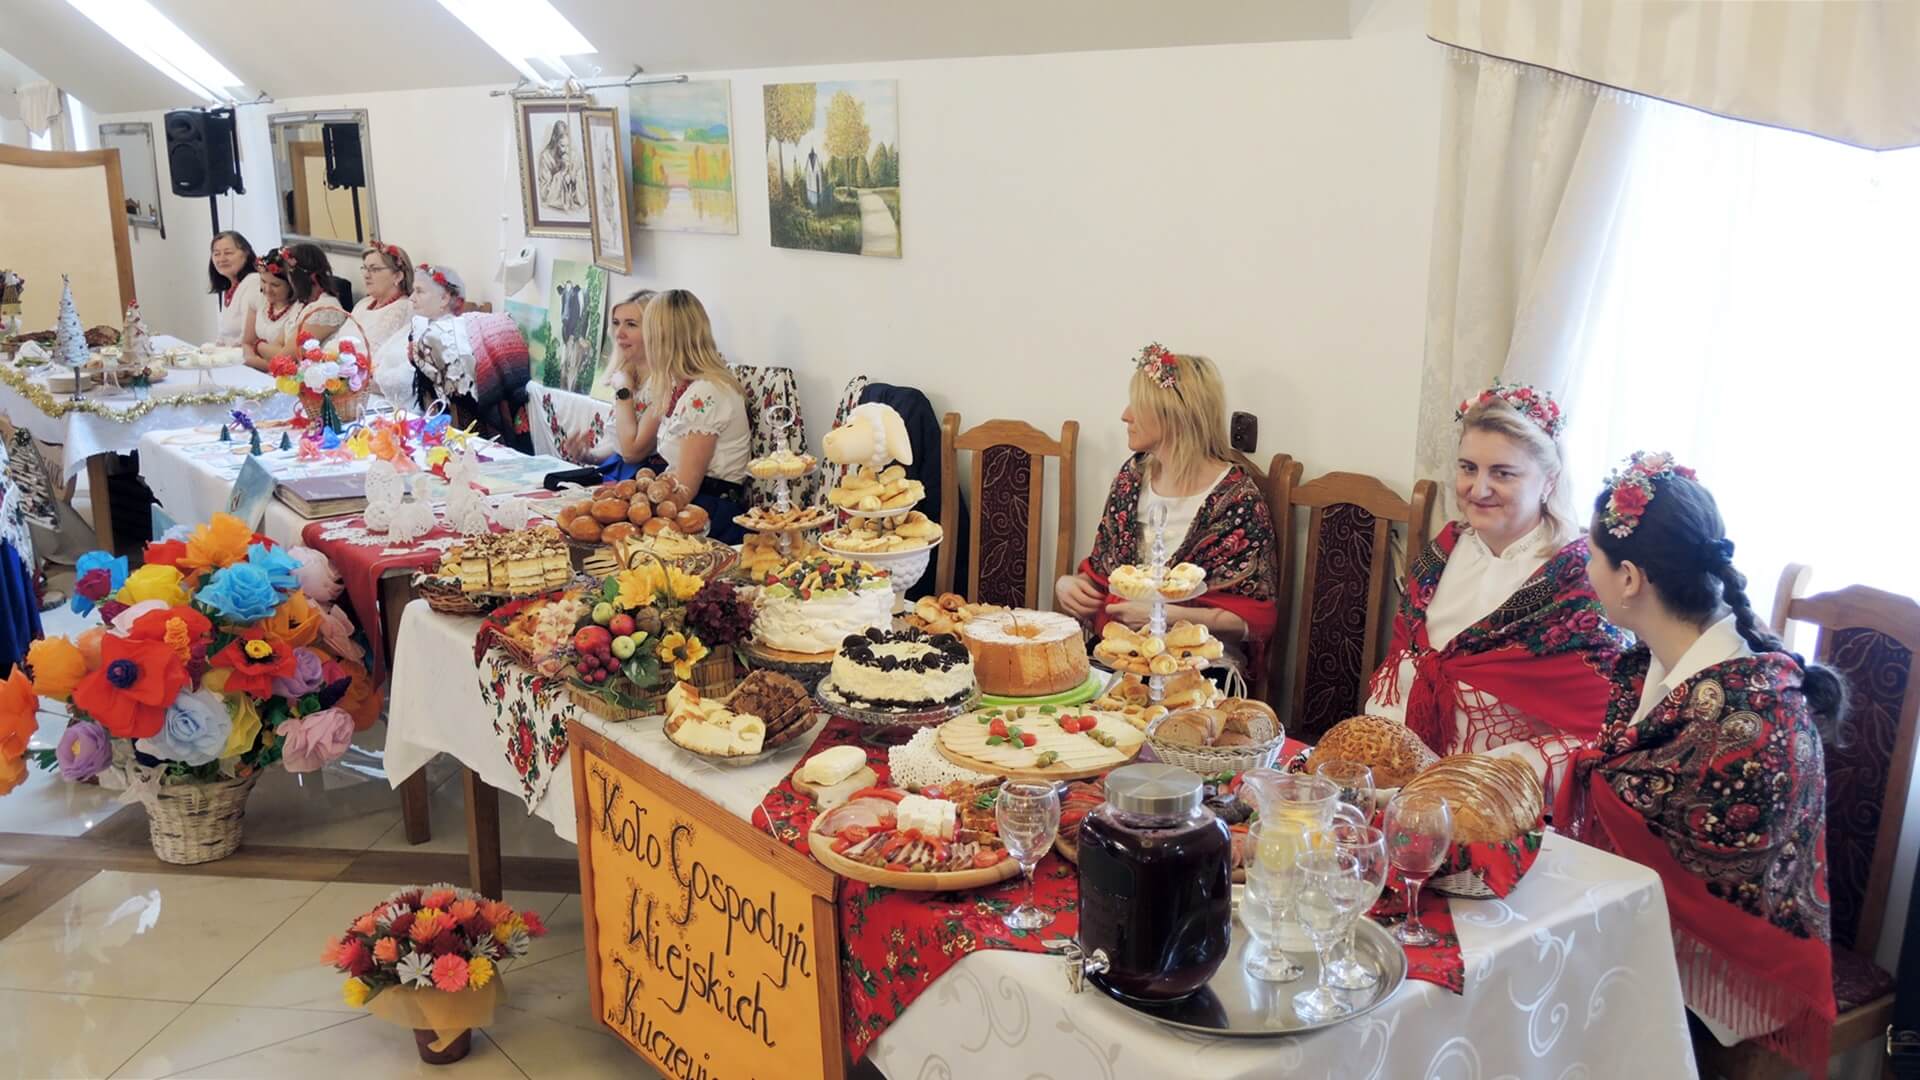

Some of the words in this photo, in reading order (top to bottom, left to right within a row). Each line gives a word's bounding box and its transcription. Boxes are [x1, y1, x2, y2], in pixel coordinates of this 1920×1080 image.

[592, 769, 662, 868] Koło
[670, 824, 811, 990] Gospodyń
[628, 887, 776, 1048] Wiejskich
